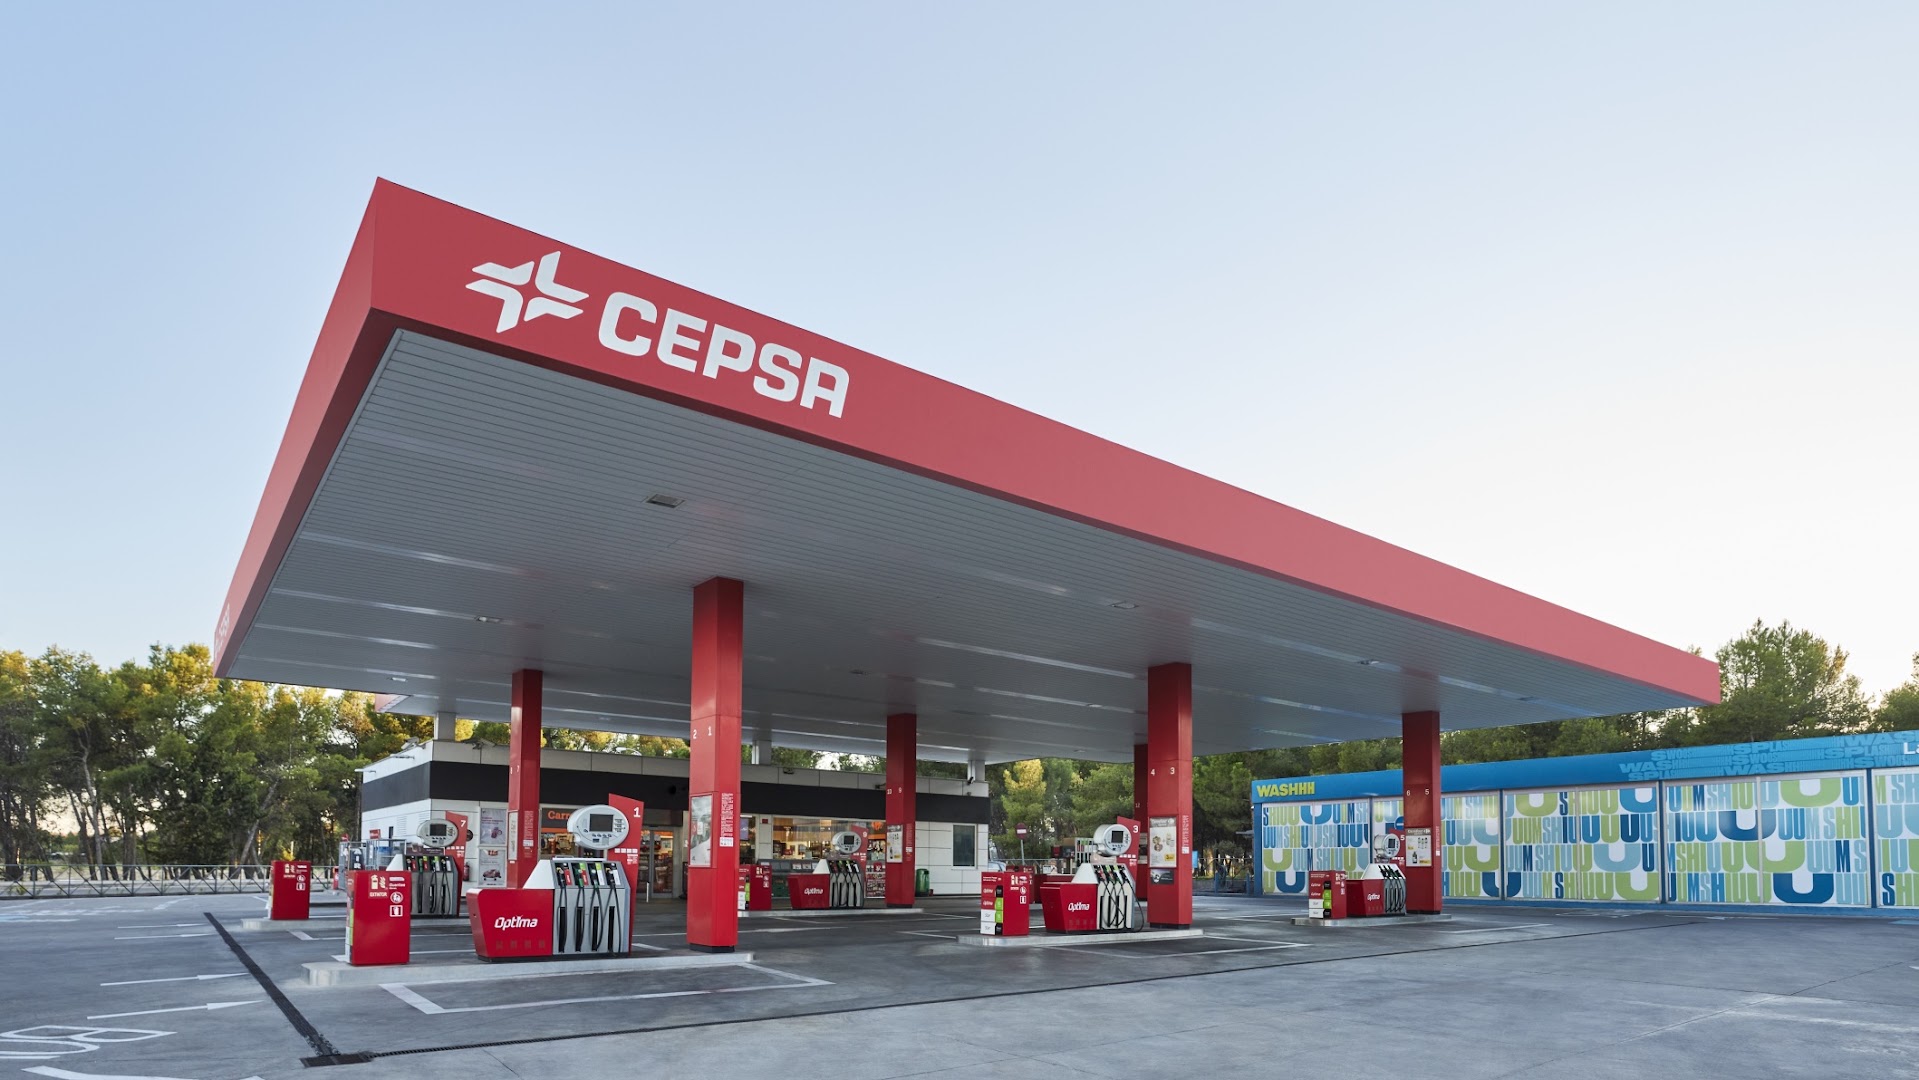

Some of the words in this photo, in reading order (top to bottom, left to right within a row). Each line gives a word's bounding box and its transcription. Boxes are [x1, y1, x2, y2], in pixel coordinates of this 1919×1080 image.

[598, 291, 850, 418] CEPSA
[693, 729, 697, 739] 2
[708, 726, 712, 736] 1
[1170, 767, 1175, 775] 3
[1256, 782, 1315, 797] WASHHH
[633, 806, 641, 818] 1
[460, 820, 466, 828] 7
[1133, 825, 1139, 833] 3
[1068, 902, 1090, 912] Optima
[494, 915, 539, 931] Optima
